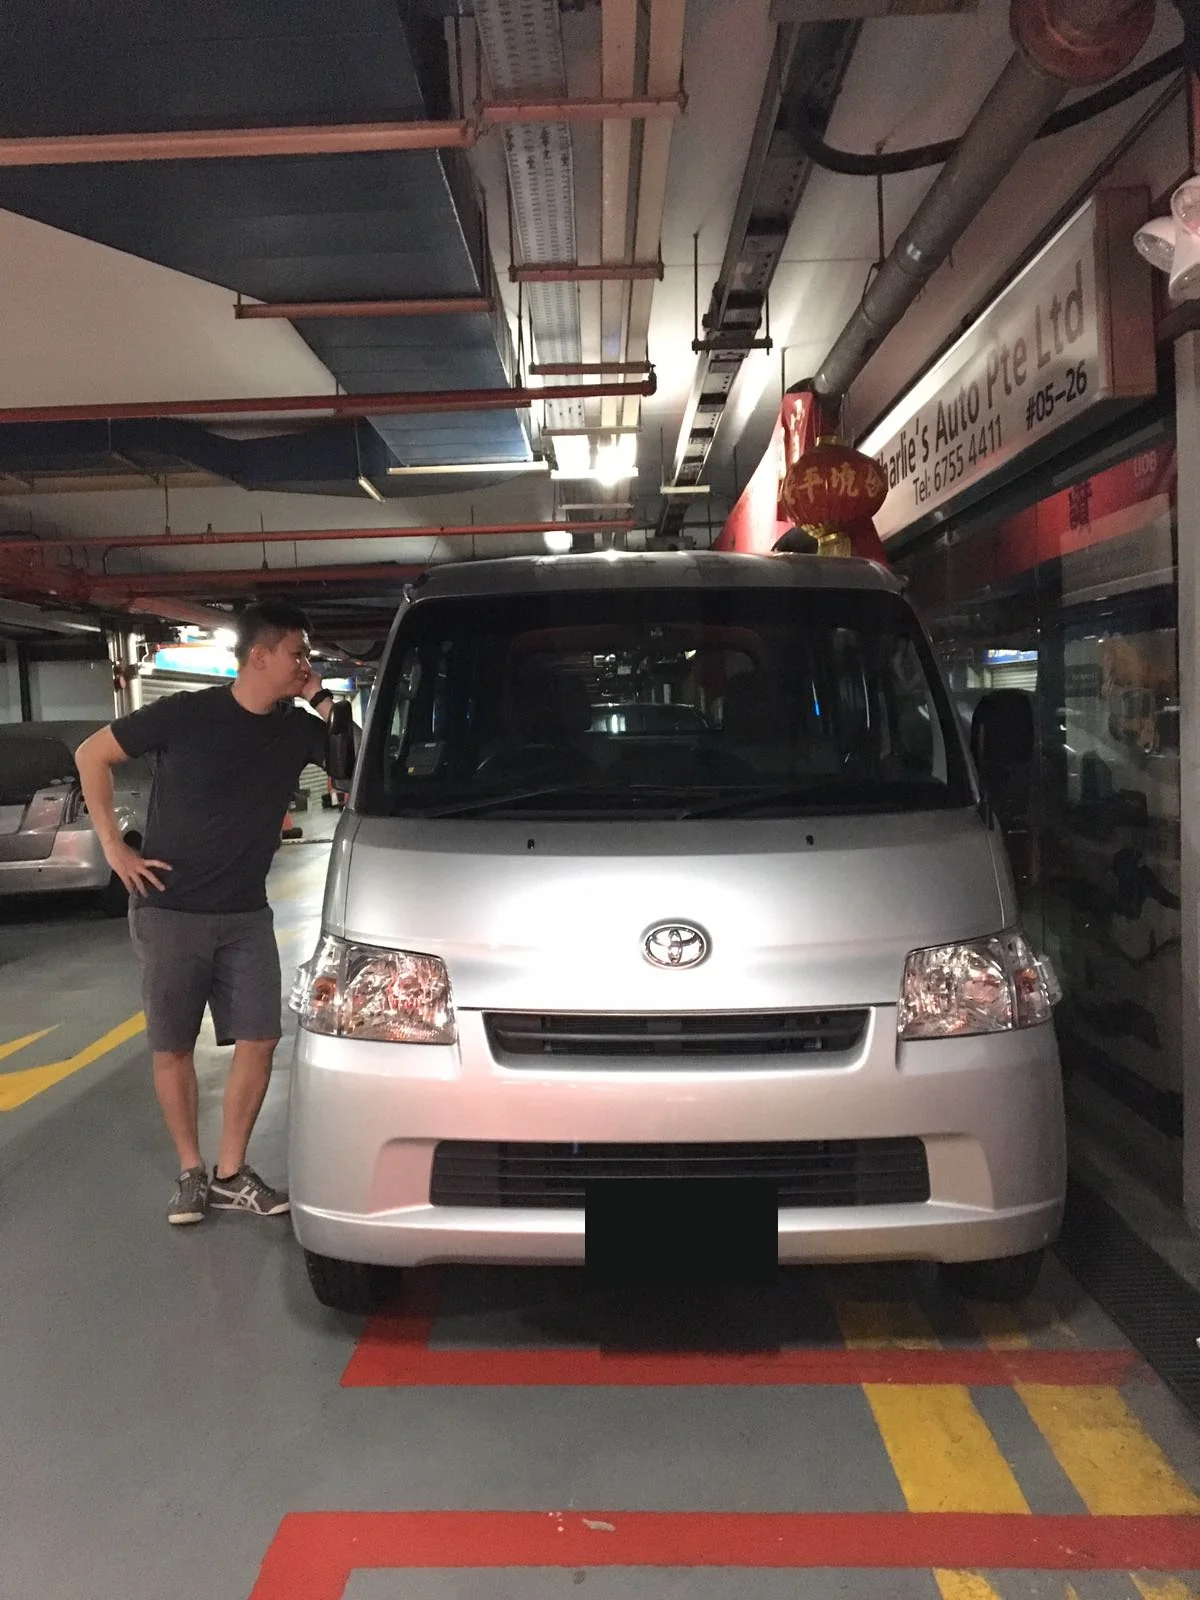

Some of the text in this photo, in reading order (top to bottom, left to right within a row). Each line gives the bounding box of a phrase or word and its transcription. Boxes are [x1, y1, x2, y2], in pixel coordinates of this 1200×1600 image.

[913, 359, 1088, 506] Tel: 6755 4411 #05-26
[936, 383, 980, 453] Auto
[986, 337, 1027, 409] Pte
[1035, 259, 1084, 370] Ltd
